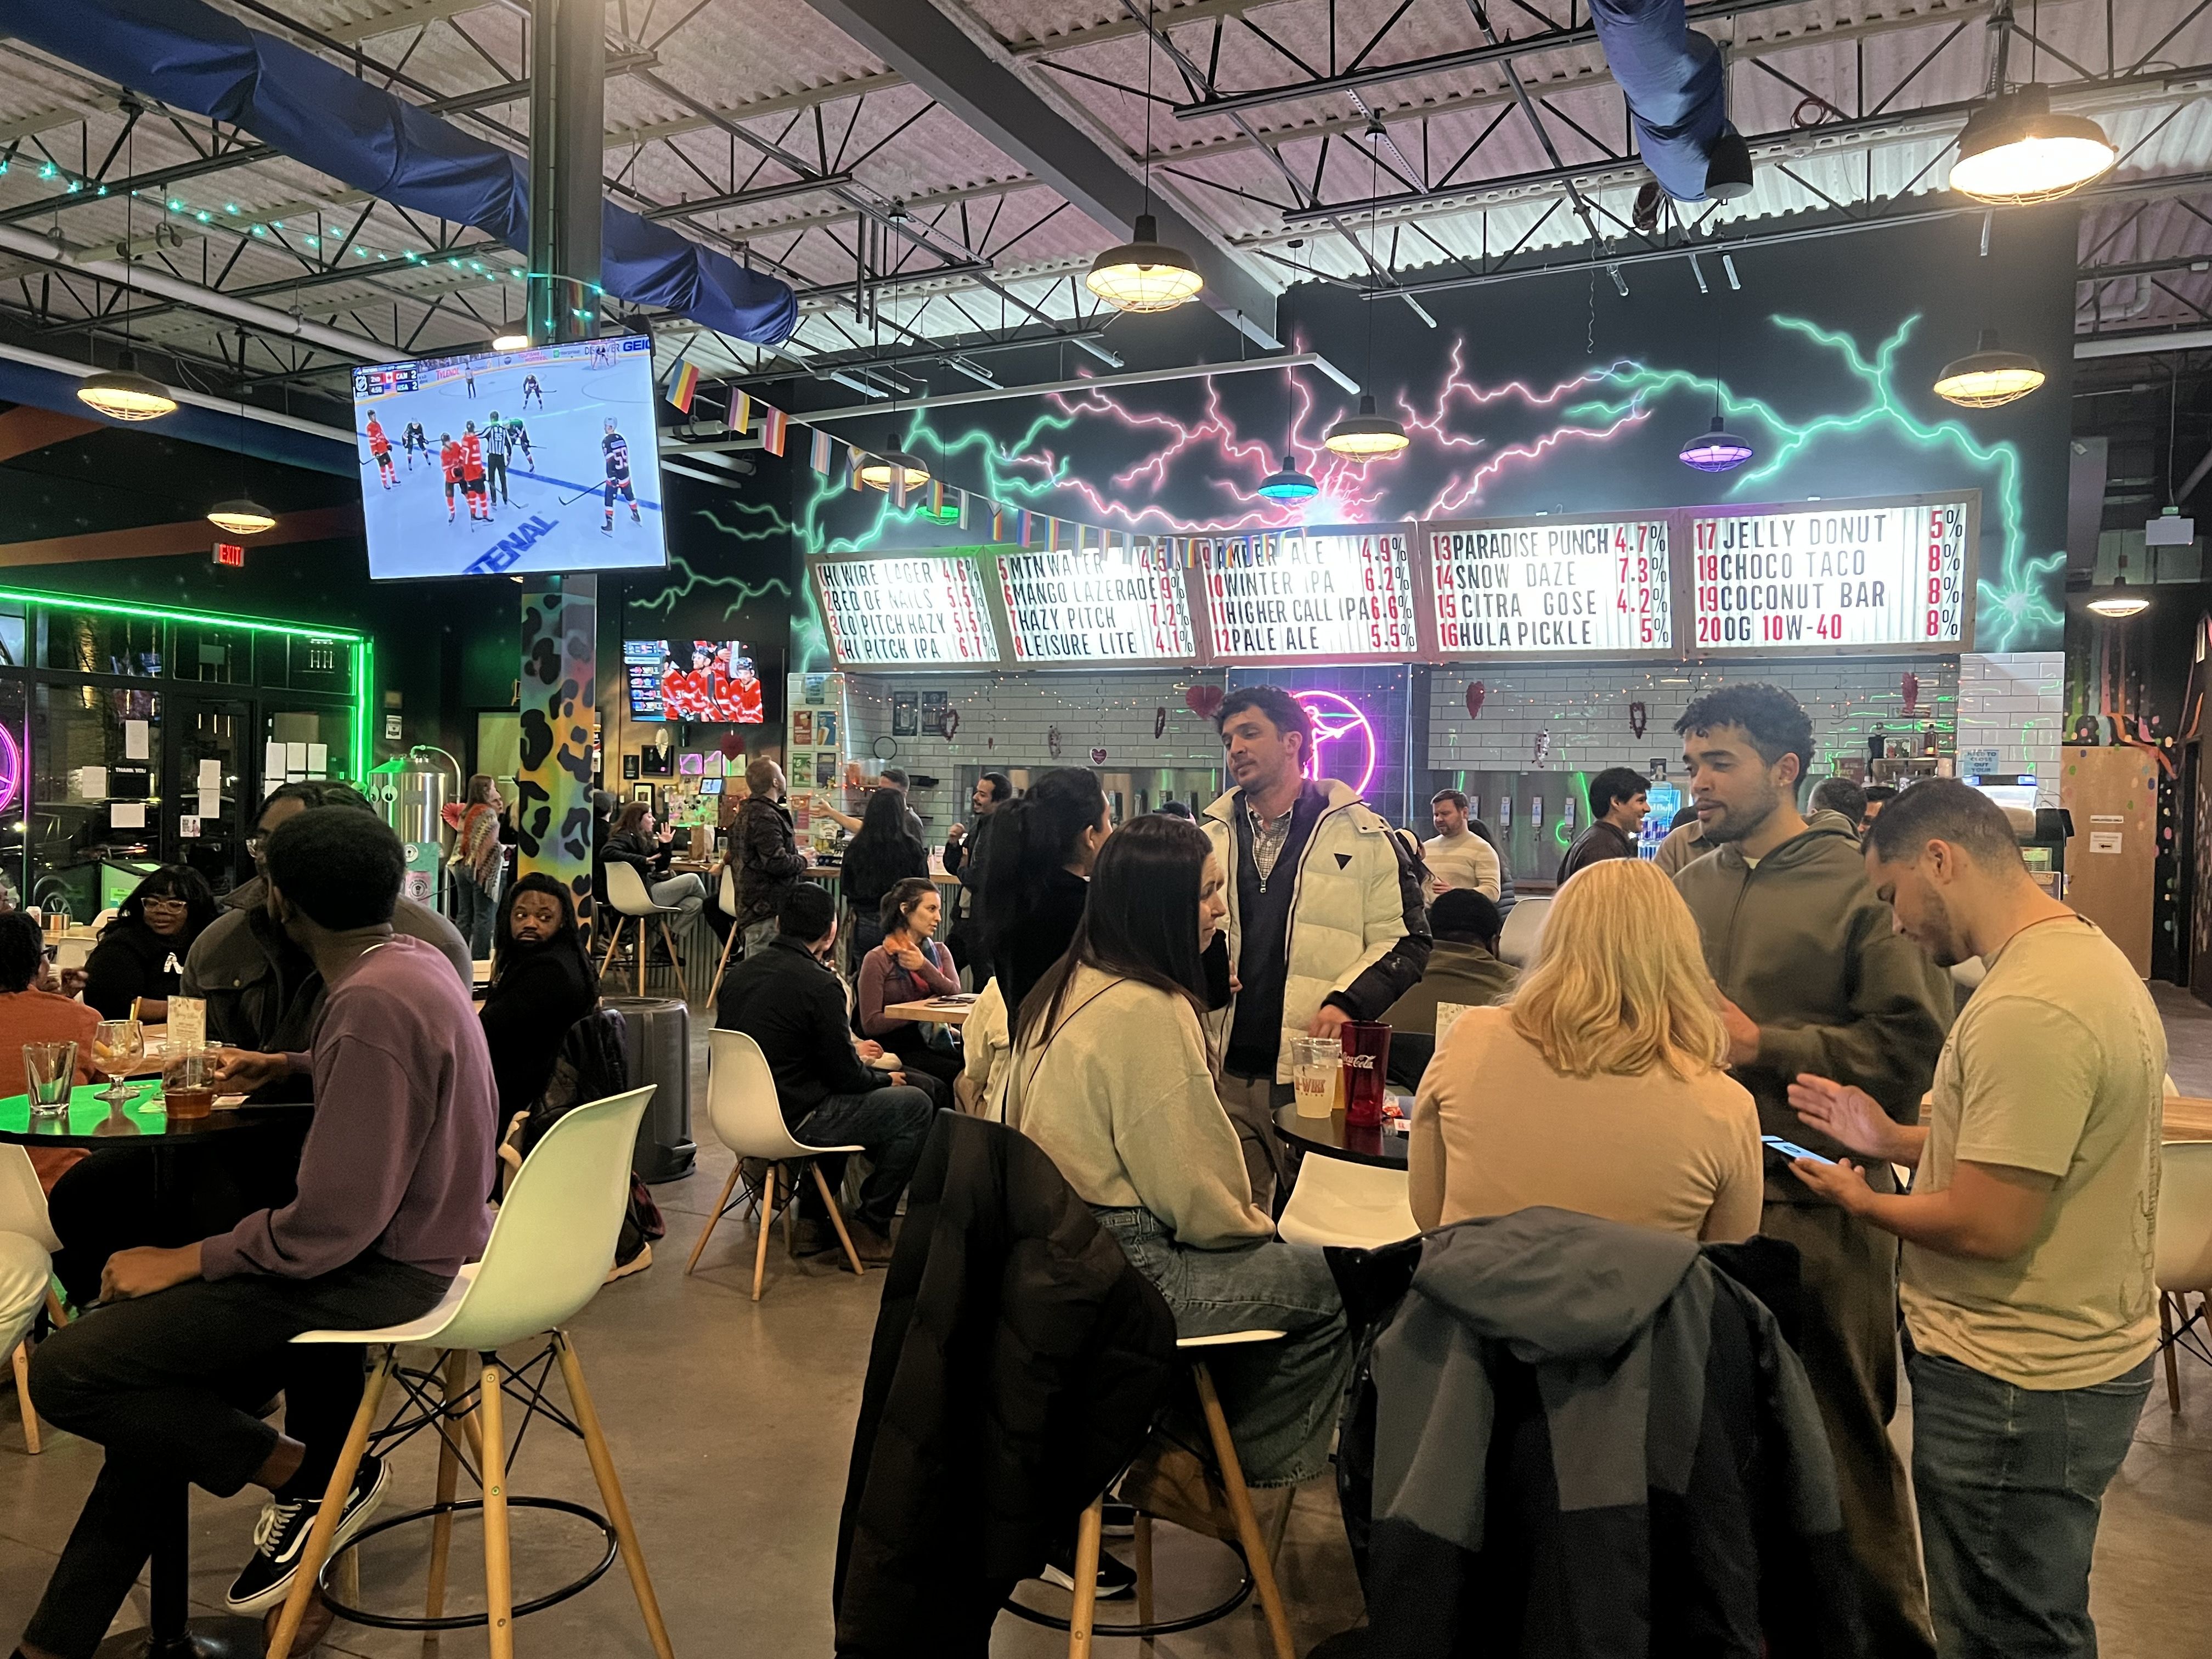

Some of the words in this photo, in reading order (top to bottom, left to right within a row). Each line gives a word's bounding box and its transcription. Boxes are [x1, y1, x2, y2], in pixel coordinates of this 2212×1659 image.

[585, 343, 619, 354] DISVER
[396, 372, 408, 380] CAN
[411, 370, 417, 379] 2
[436, 368, 459, 381] TYLENOL
[612, 447, 628, 470] 59
[1432, 535, 1452, 561] 13
[1453, 532, 1539, 560] PARADISE
[1548, 528, 1609, 556] PUNCH
[1615, 525, 1665, 553] 4.7%
[1696, 522, 1717, 550] 17
[1723, 520, 1795, 549] JELLY
[1810, 515, 1886, 545] DONUT
[1929, 509, 1962, 539] 5%
[219, 544, 241, 566] EXIT
[998, 557, 1008, 580] 5
[1010, 555, 1046, 579] MTN
[1141, 549, 1181, 573] 4.5
[1292, 540, 1324, 565] ALE
[1362, 537, 1407, 563] 4.9%
[1697, 554, 1718, 582] 18
[1721, 552, 1792, 581] CHOCO
[1805, 549, 1865, 577] TACO
[1928, 543, 1961, 572] 8%
[817, 566, 826, 586] 1
[823, 565, 839, 586] HI
[841, 564, 879, 586] WIRE
[884, 562, 933, 584] LAGER
[943, 560, 980, 583] 4.6%
[1207, 573, 1224, 598] 10
[1224, 571, 1294, 597] WINTER
[1305, 570, 1335, 594] IPA
[1365, 566, 1409, 591] 6.2%
[1436, 564, 1454, 590] 14
[1455, 563, 1509, 589] SNOW
[1526, 561, 1576, 587] DAZE
[1619, 556, 1667, 583] 7.3%
[824, 590, 834, 611] 2
[832, 590, 860, 611] BED
[864, 590, 882, 610] OF
[888, 588, 933, 610] NAILS
[947, 585, 984, 608] 5.5%
[1004, 584, 1014, 606] 6
[1013, 582, 1068, 605] MANGO
[1074, 577, 1158, 602] LAZERADE
[1161, 576, 1185, 599] 9%
[1437, 594, 1455, 618] 15
[1462, 592, 1522, 618] CITRA
[1544, 590, 1597, 616] GOSE
[1617, 587, 1668, 613] 4.2%
[1698, 585, 1718, 612] 19
[1721, 583, 1825, 611] COCONUT
[1840, 580, 1884, 608] BAR
[1928, 575, 1959, 605] 8%
[830, 616, 840, 635] 3
[839, 615, 857, 635] LO
[860, 614, 905, 635] PITCH
[907, 612, 946, 634] HAZY
[953, 611, 991, 633] 5.5%
[1010, 610, 1017, 632] 7
[1018, 608, 1059, 631] HAZY
[1068, 606, 1116, 629] PITCH
[1150, 603, 1189, 627] 7.2%
[1210, 601, 1226, 625] 11
[1225, 600, 1288, 624] HIGHER
[1293, 598, 1333, 622] CALL
[1339, 596, 1370, 621] IPA
[1370, 595, 1412, 620] 6.6%
[1698, 616, 1721, 642] 20
[1724, 616, 1751, 641] OG
[1763, 613, 1842, 641] 10W-40
[1926, 607, 1958, 636] 8%
[1015, 635, 1024, 657] 8
[1024, 633, 1092, 656] LEISURE
[1099, 631, 1137, 654] LITE
[1156, 630, 1193, 653] 4.1%
[1214, 629, 1231, 652] 12
[1232, 628, 1277, 651] PALE
[1286, 626, 1319, 650] ALE
[1371, 623, 1415, 648] 5.5%
[1440, 623, 1458, 647] 16
[1459, 622, 1511, 646] HULA
[1517, 620, 1592, 646] PICKLE
[1641, 617, 1669, 643] 5%
[838, 639, 846, 659] 4
[844, 639, 861, 659] HI
[864, 638, 910, 659] PITCH
[915, 637, 941, 659] IPA
[960, 636, 997, 658] 6.7%
[1656, 803, 1673, 812] Bull
